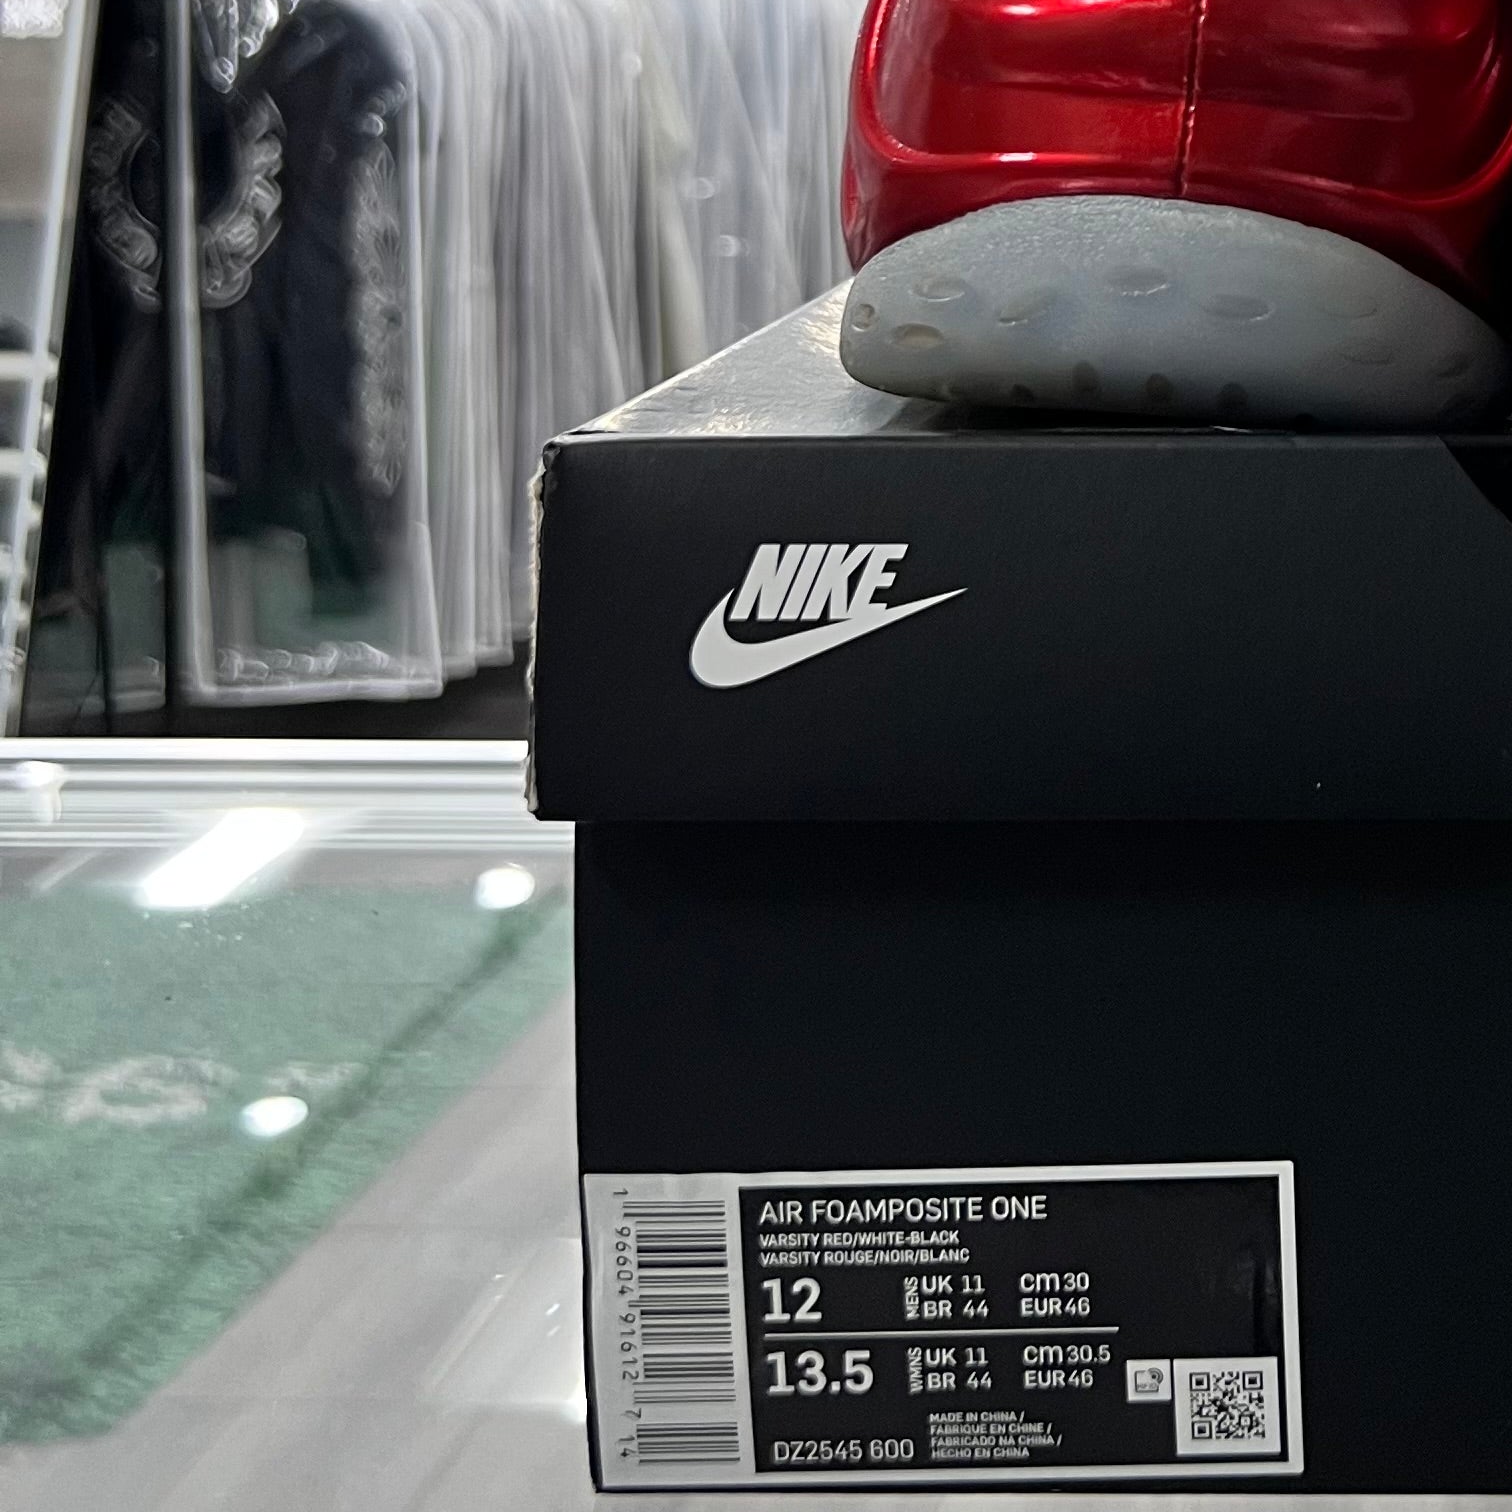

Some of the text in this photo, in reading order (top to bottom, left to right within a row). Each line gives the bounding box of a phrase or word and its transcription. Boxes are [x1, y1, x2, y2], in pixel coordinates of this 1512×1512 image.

[728, 543, 909, 622] NIKE
[759, 1195, 1048, 1225] AIR FOAMPOSITE ONE
[759, 1229, 960, 1248] VARSITY RED/WHITE-BLACK
[615, 1226, 634, 1295] 96604
[760, 1248, 970, 1267] VARSITY ROUGE/NOIR/BLANC
[921, 1274, 986, 1295] UK 11
[762, 1277, 823, 1323] 12
[923, 1299, 989, 1319] BR 44
[619, 1312, 640, 1380] 91612
[925, 1347, 989, 1368] UK 11
[766, 1349, 874, 1395] 13.5
[908, 1346, 924, 1395] WMNS
[926, 1371, 992, 1392] BR 44
[929, 1412, 964, 1423] MADE
[966, 1411, 978, 1422] IN
[980, 1411, 1017, 1422] CHINA
[930, 1424, 988, 1435] FABRIQUE
[990, 1423, 1006, 1434] EN
[1008, 1422, 1044, 1433] CHINE
[774, 1438, 914, 1462] DZ2545 600
[931, 1436, 996, 1447] FABRICADO
[998, 1435, 1015, 1446] NA
[1018, 1434, 1055, 1445] CHINA
[932, 1446, 1030, 1459] HECHO EN CHINA
